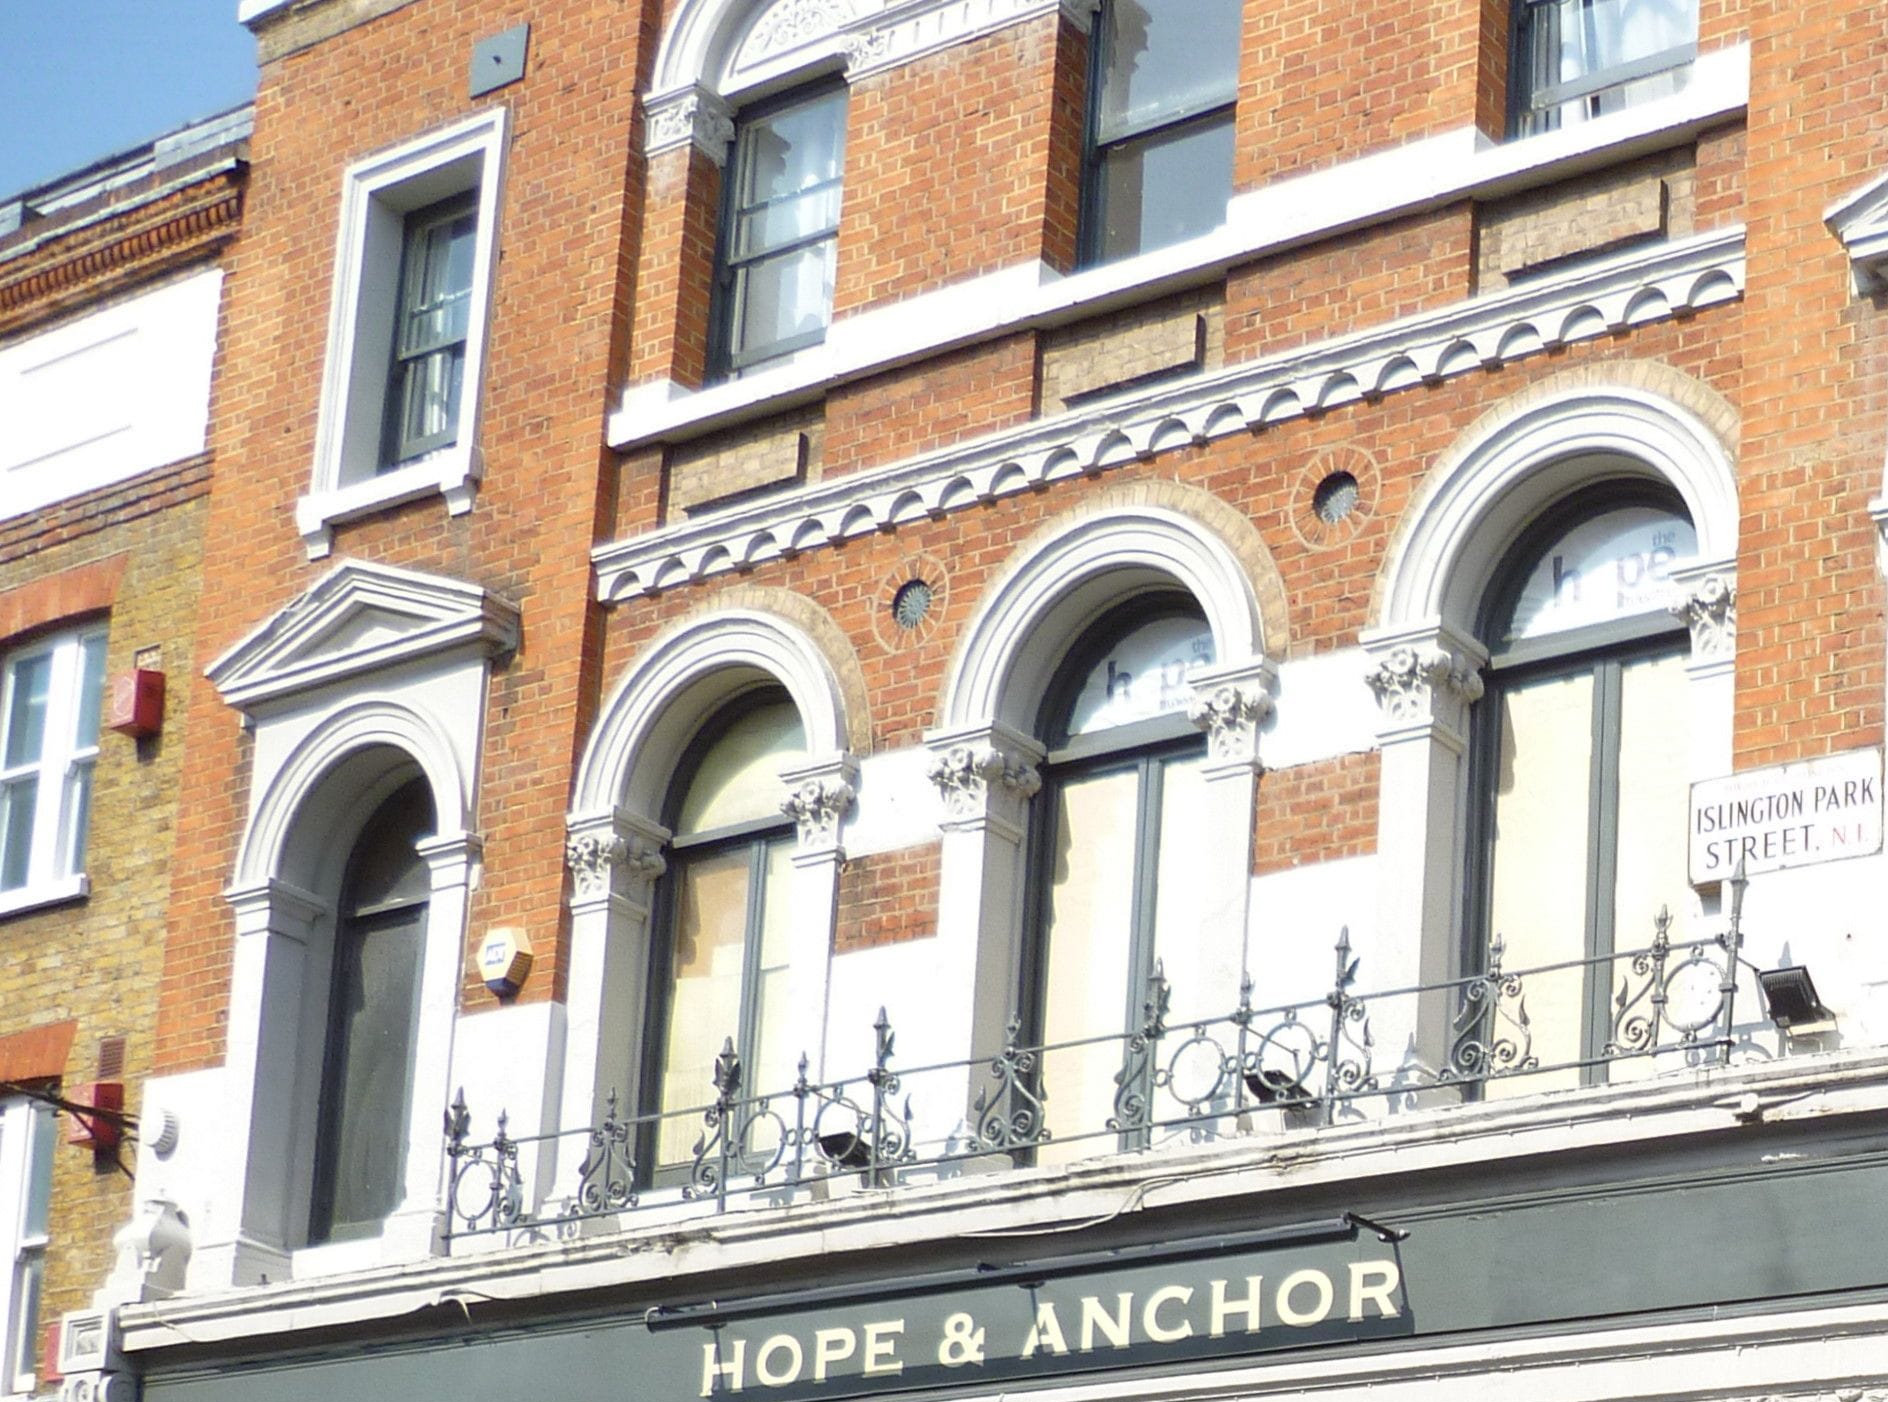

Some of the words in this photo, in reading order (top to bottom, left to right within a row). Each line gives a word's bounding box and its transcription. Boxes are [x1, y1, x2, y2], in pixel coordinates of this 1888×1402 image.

[1697, 789, 1804, 835] ISLINGTON
[1815, 777, 1875, 813] PARK
[699, 1320, 906, 1398] HOPE
[937, 1312, 987, 1368] &
[1021, 1259, 1401, 1360] ANCHOR
